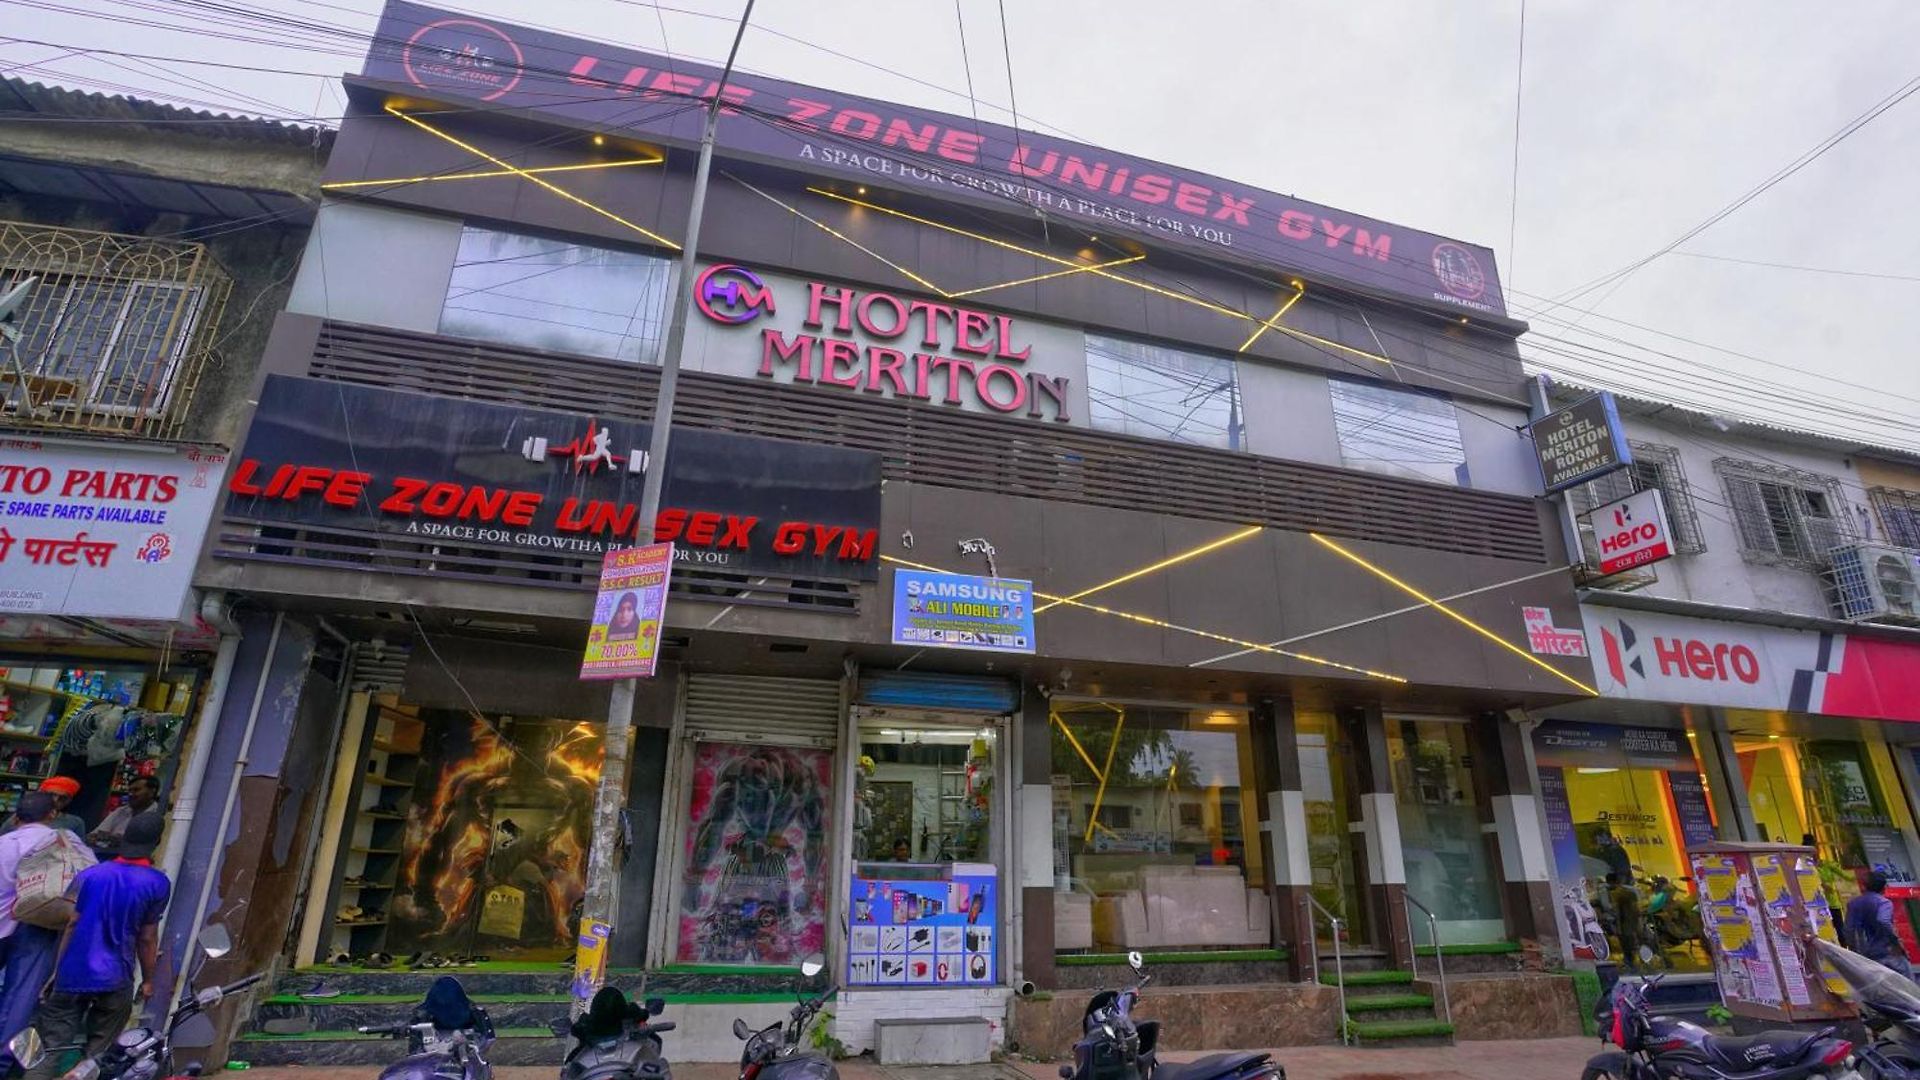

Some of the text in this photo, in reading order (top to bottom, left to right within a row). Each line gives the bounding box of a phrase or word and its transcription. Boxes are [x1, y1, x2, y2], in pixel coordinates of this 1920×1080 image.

[568, 56, 1392, 262] LIFE ZONE UNISEX GYM
[800, 143, 1233, 247] A SPACE FOR GROWTH A PLACE FOR YOU
[804, 281, 1032, 362] HOTEL
[757, 328, 1071, 422] MERITON
[1541, 425, 1609, 463] MERITON
[1547, 418, 1595, 446] HOTEL
[1553, 454, 1610, 483] AVAILABLE
[1555, 443, 1600, 470] ROOM
[60, 469, 179, 503] PARTS
[7, 501, 51, 518] SPARE
[52, 504, 95, 521] PARTS
[95, 506, 167, 525] AVAILABLE
[229, 459, 880, 562] LIFE ZONE UNSEX GYM
[406, 521, 418, 533] A
[422, 523, 475, 540] SPACE
[477, 529, 511, 543] FOR
[696, 550, 729, 565] YOU
[1601, 522, 1657, 554] Hero
[906, 580, 1024, 604] SAMSUNG
[926, 600, 1000, 618] ALI MOBILE
[1653, 636, 1760, 684] Hero
